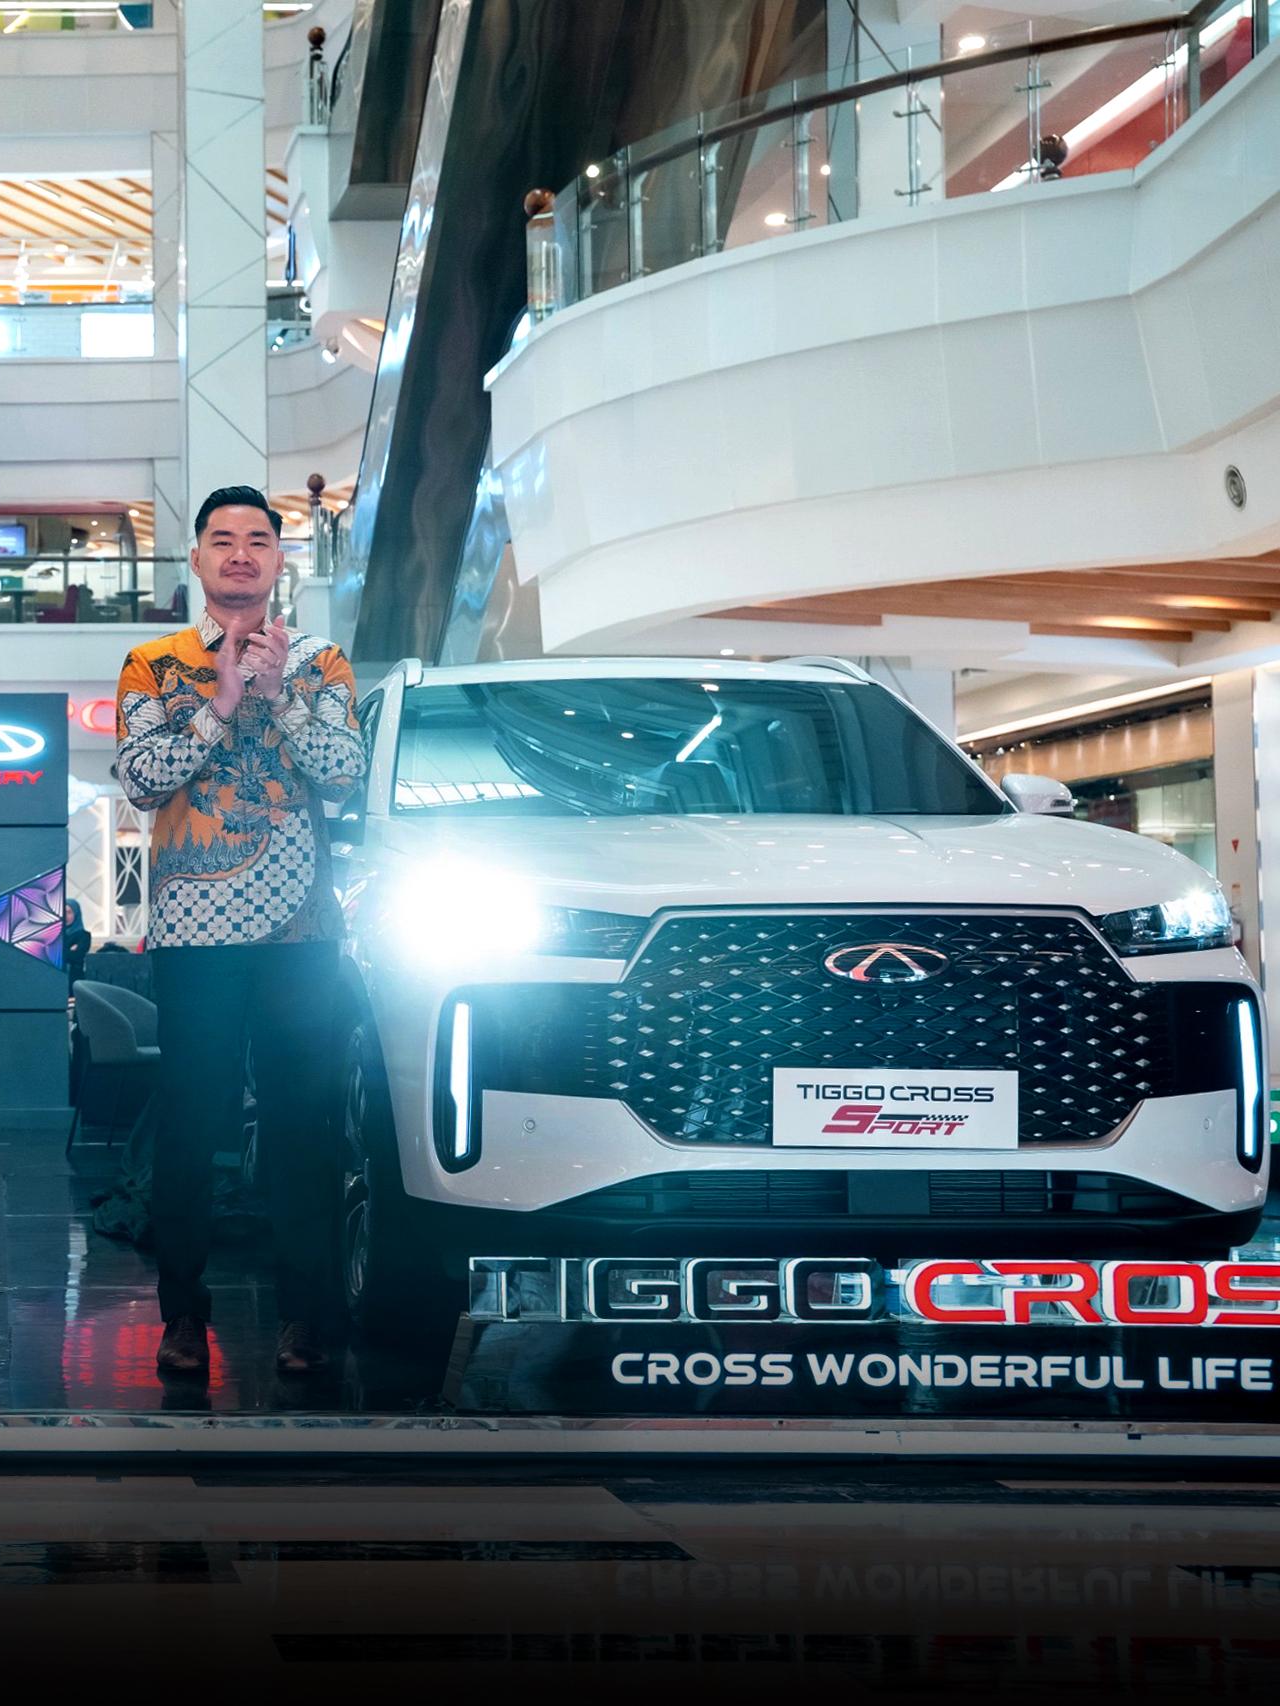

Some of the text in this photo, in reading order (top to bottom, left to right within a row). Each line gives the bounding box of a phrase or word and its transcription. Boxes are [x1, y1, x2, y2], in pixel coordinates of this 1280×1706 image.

[797, 1084, 995, 1103] TIGGO CROSS
[821, 1104, 965, 1136] SPORT
[469, 1257, 880, 1323] TIGGO
[611, 1352, 1274, 1391] CROSS WONDERFUL LIFE
